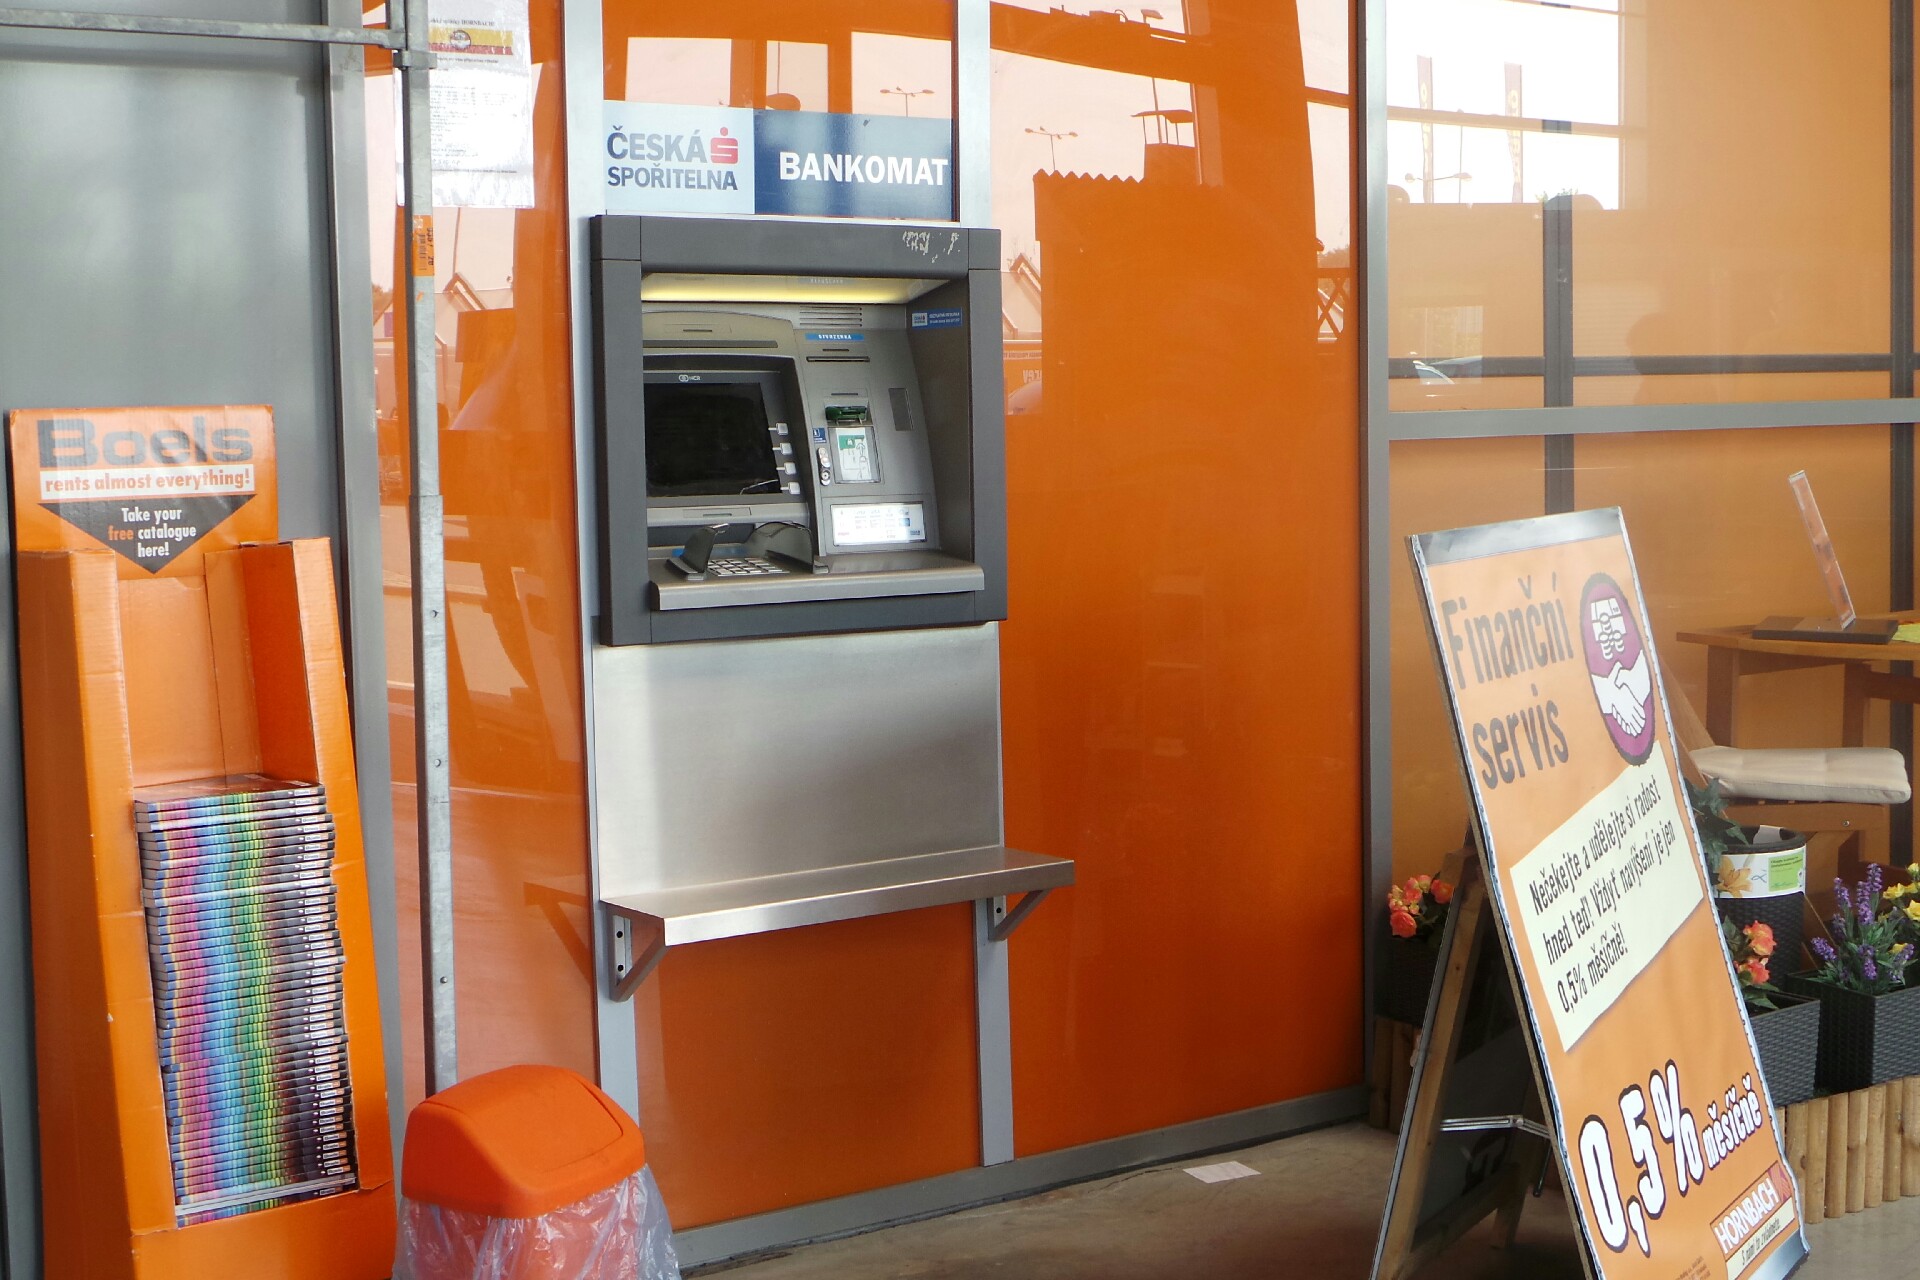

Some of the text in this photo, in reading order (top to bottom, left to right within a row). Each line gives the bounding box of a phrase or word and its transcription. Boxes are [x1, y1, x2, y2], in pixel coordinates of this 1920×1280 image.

[607, 125, 708, 164] ČESKÁ
[779, 151, 949, 186] BANKOMAT
[607, 163, 738, 191] SPOŘITELNA
[38, 415, 254, 468] Boels
[45, 468, 250, 493] rents almost everything!
[108, 522, 197, 541] free catalogue
[121, 507, 182, 525] Take your
[137, 541, 170, 558] here!
[1441, 572, 1574, 690] Finanční
[1472, 684, 1569, 790] servis
[1529, 852, 1582, 916] Nečekejte
[1582, 845, 1591, 870] a
[1589, 811, 1627, 862] udělejte
[1625, 795, 1636, 828] si
[1543, 915, 1574, 965] hned
[1590, 868, 1621, 917] Vždyť
[1619, 831, 1655, 893] navýšení
[1652, 829, 1665, 866] je
[1659, 820, 1676, 857] jen
[1556, 920, 1629, 1013] 0,5% měsíčně!
[1578, 1059, 1763, 1258] 0,5% měsíčně
[1714, 1178, 1780, 1254] HORNBACH
